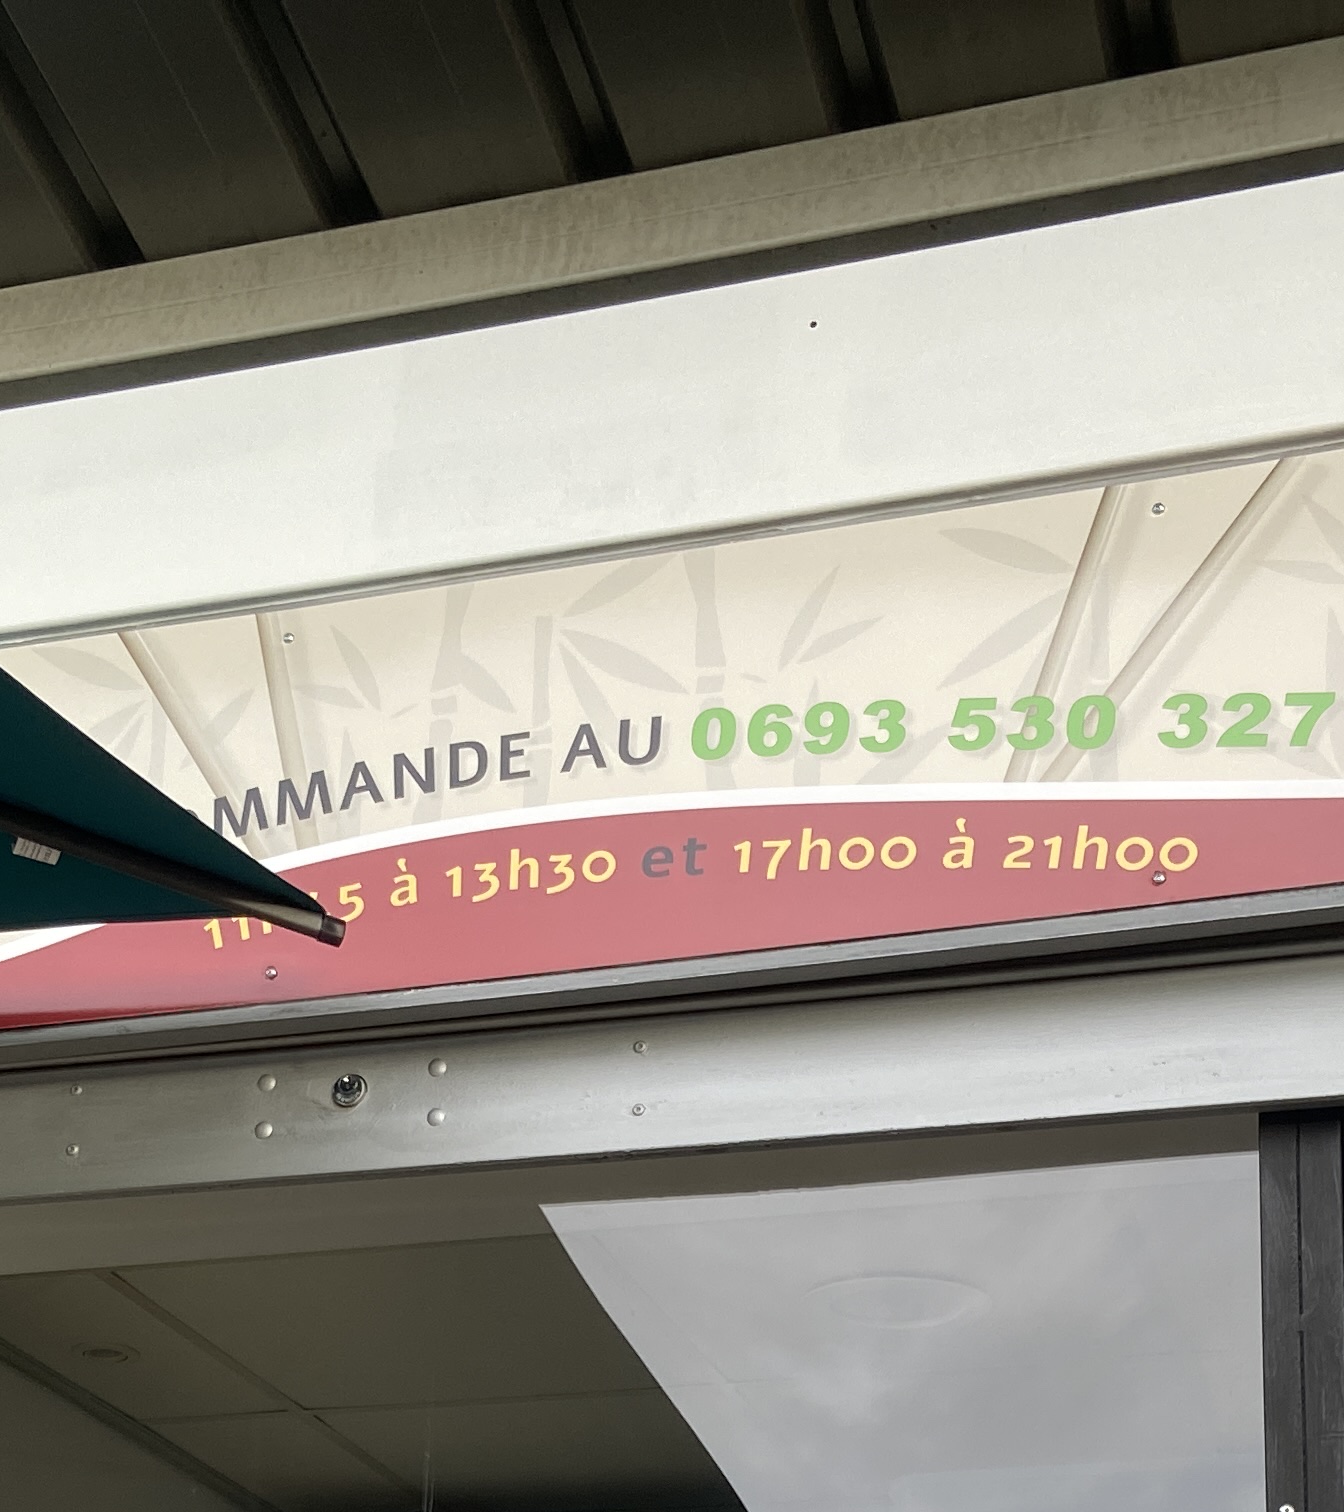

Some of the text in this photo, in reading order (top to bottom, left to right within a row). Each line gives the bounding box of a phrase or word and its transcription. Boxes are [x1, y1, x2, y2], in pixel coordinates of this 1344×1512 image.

[186, 691, 1338, 837] MMANDE AU 0693 530 327
[203, 818, 1200, 949] 115 à 13h30 et 17h00 à 21h00
